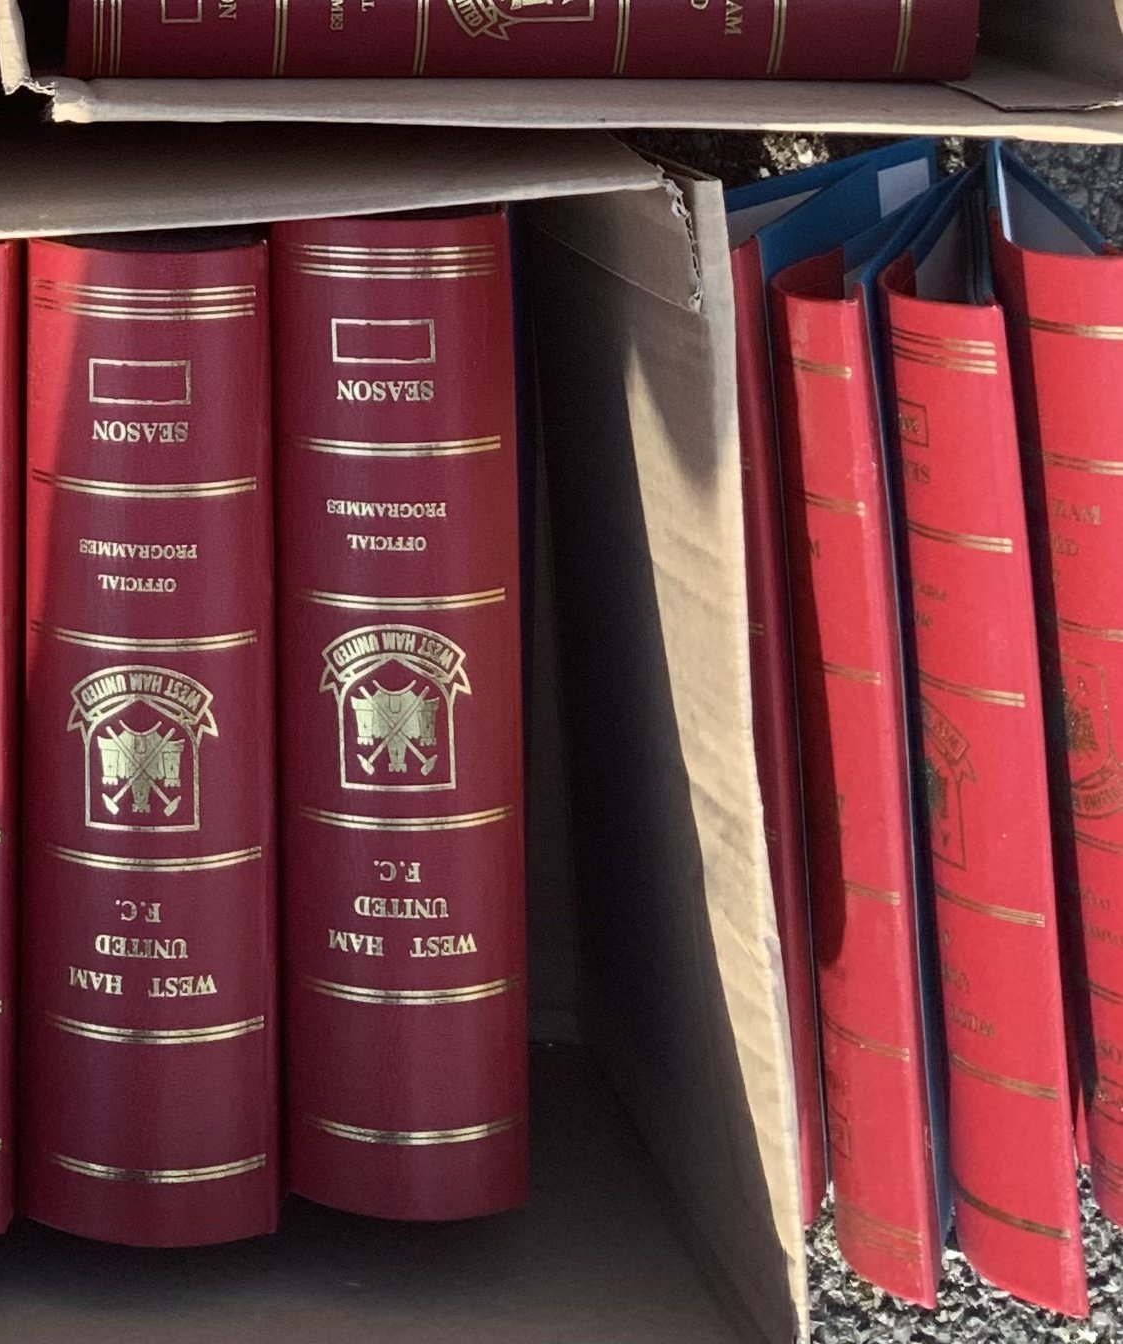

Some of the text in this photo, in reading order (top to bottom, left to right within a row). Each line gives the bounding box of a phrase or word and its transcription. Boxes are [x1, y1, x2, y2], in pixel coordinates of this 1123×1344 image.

[337, 380, 433, 401] SEASON
[92, 420, 188, 443] SEASON
[98, 574, 176, 592] OFFICIAL
[354, 896, 449, 919] UNITED
[95, 935, 188, 959] UNITED
[329, 929, 477, 957] WEST HAM
[70, 967, 217, 997] WEST HAM
